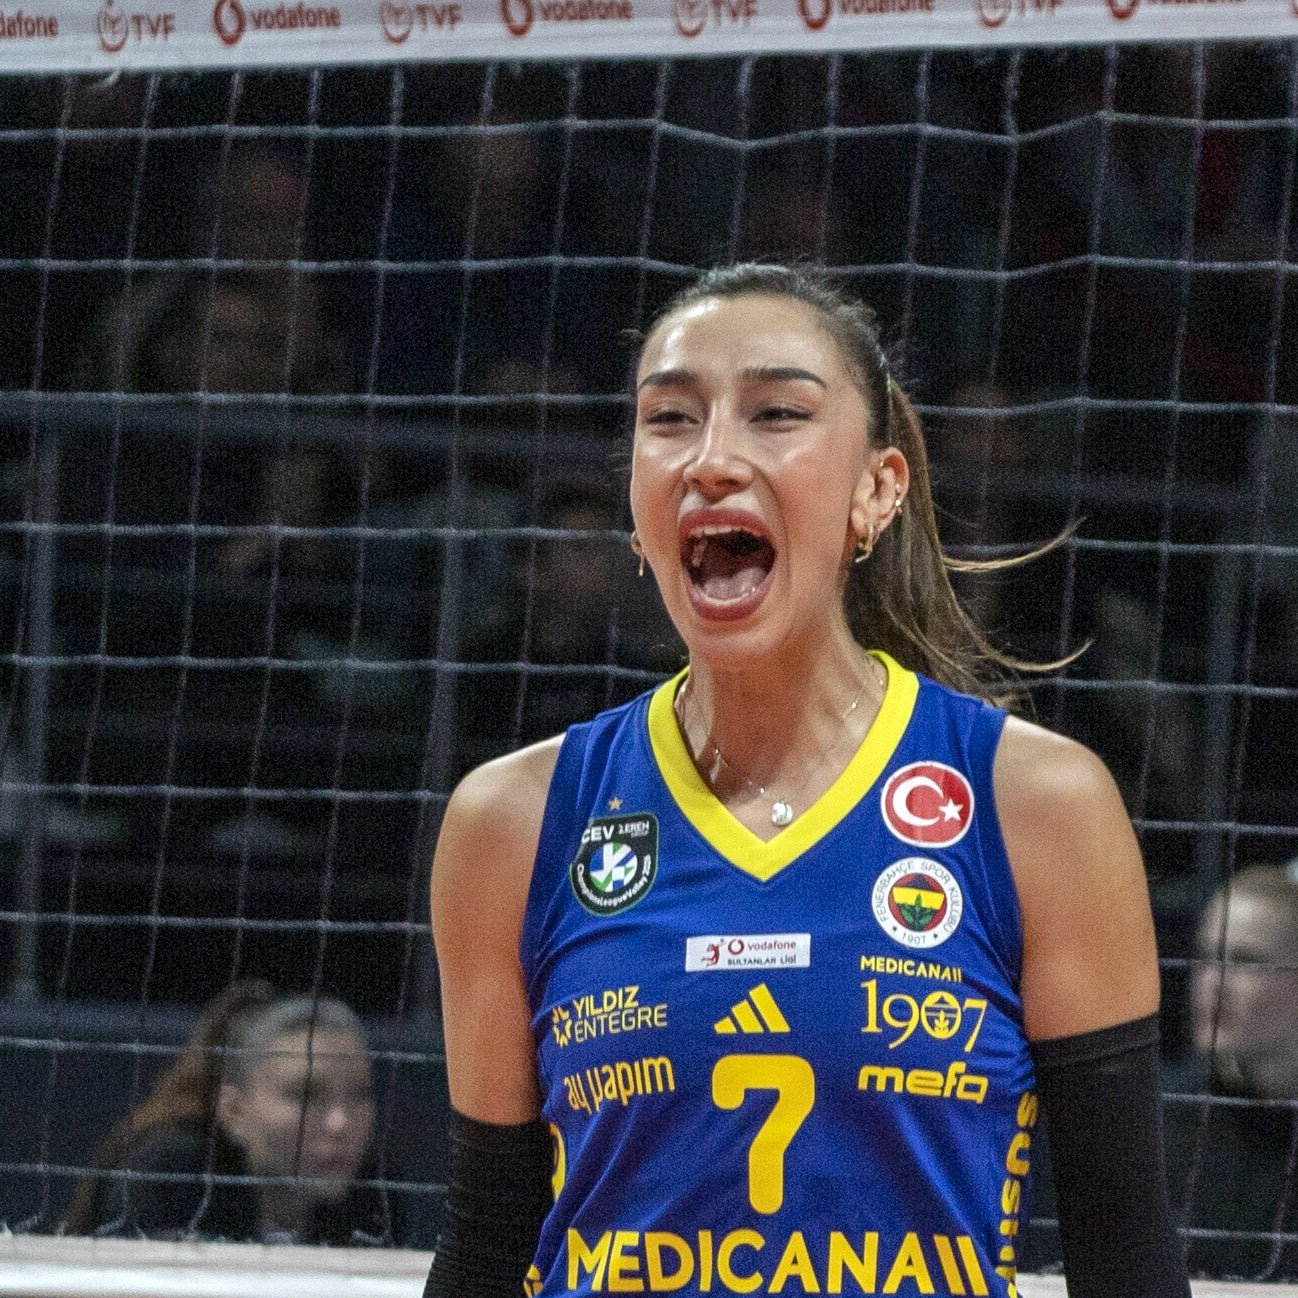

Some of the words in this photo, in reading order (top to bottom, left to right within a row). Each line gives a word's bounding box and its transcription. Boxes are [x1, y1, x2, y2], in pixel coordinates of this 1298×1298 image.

[248, 5, 341, 30] vodafone
[582, 825, 614, 844] CEV
[748, 940, 796, 951] vodafone
[573, 985, 639, 1019] YILDIZ
[860, 978, 988, 1053] 1907
[575, 1003, 668, 1042] ENTEGRE
[858, 1061, 989, 1104] mefa
[712, 1053, 815, 1215] 7
